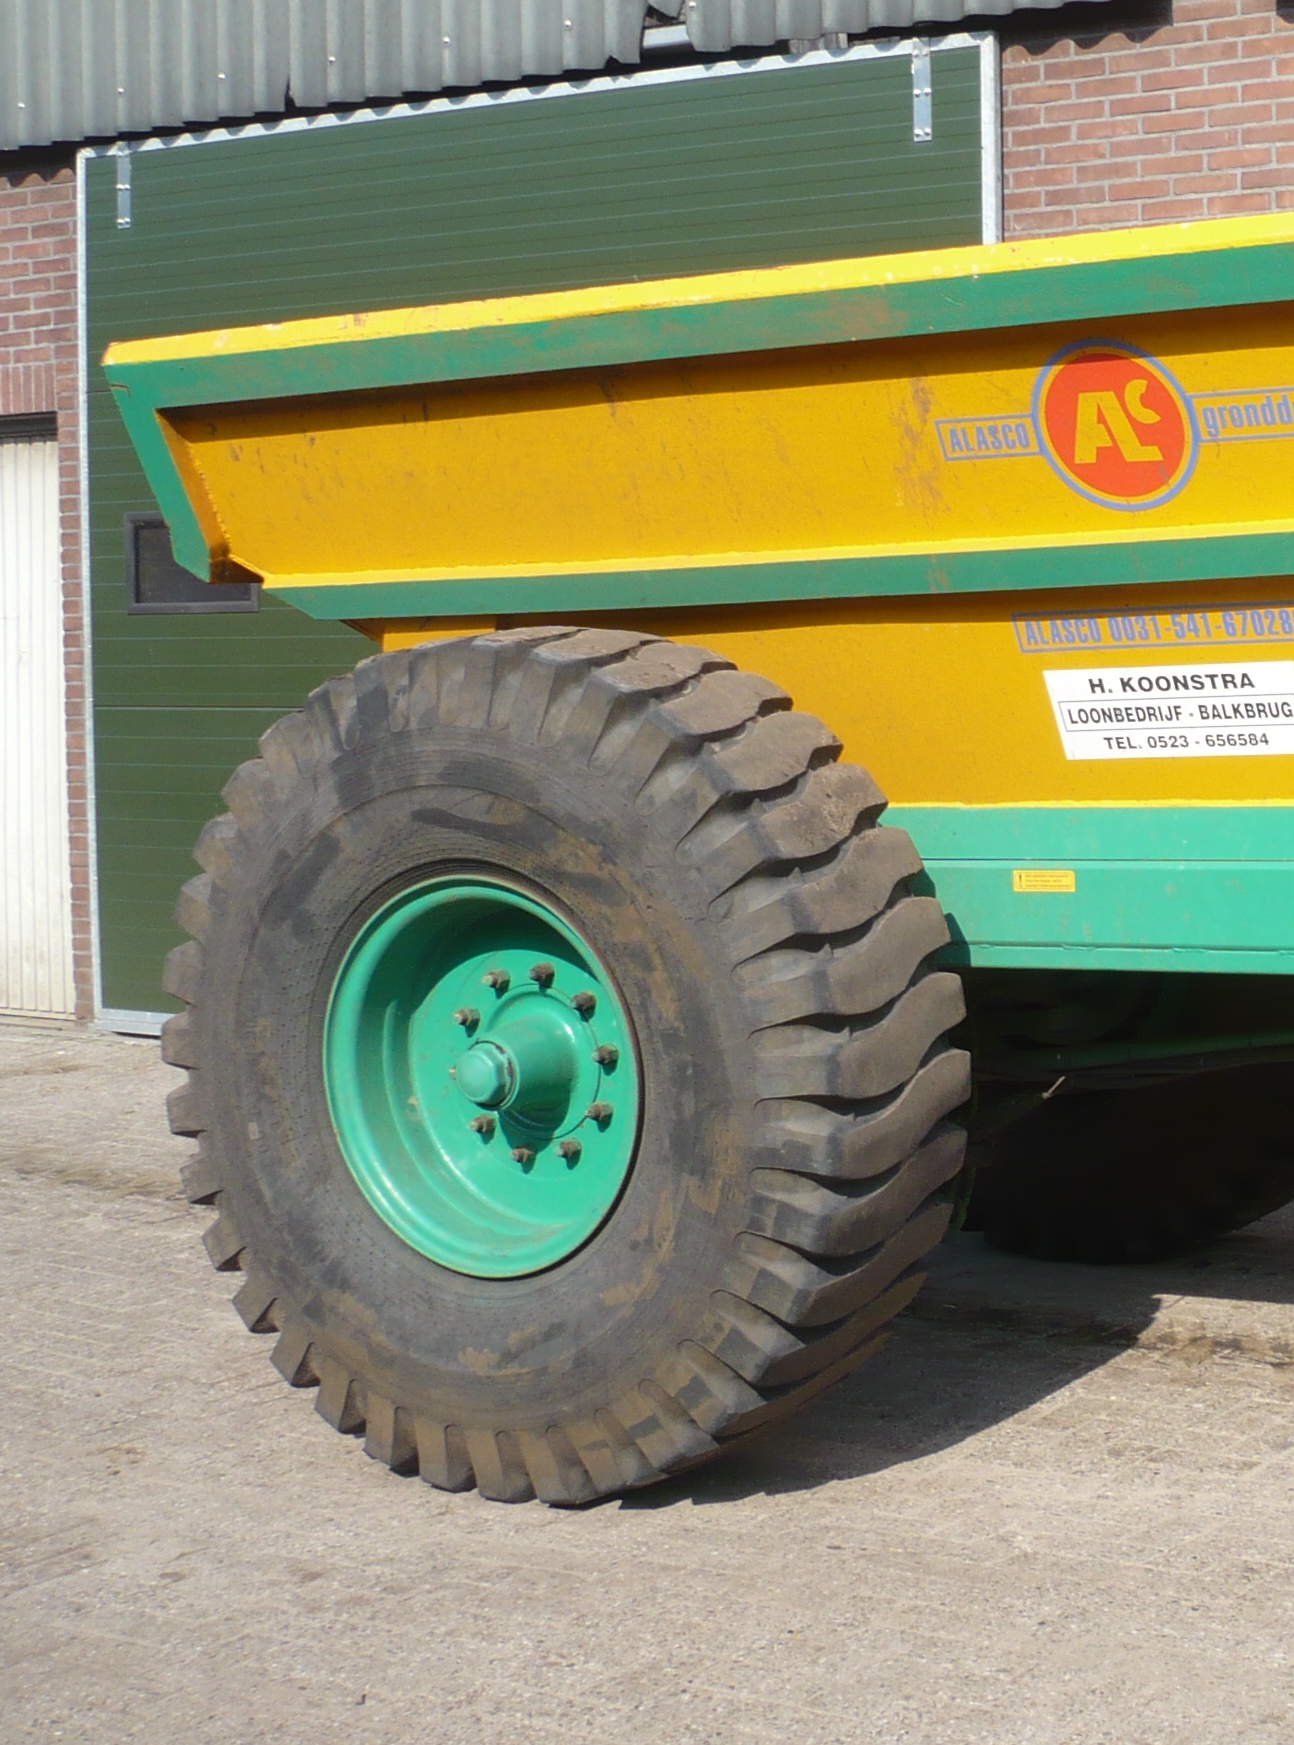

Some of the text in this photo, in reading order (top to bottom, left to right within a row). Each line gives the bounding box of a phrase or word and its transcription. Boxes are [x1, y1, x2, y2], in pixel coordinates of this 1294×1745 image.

[949, 422, 1030, 453] ALASCO
[1024, 616, 1103, 646] ALASCO
[1088, 672, 1256, 695] H. KOONSTRA
[1067, 704, 1184, 726] LOONBEDRIJF
[1198, 701, 1294, 721] BALKBRUG
[1103, 735, 1143, 751] TEL.
[1147, 734, 1190, 750] 0523
[1205, 732, 1270, 748] 656584
